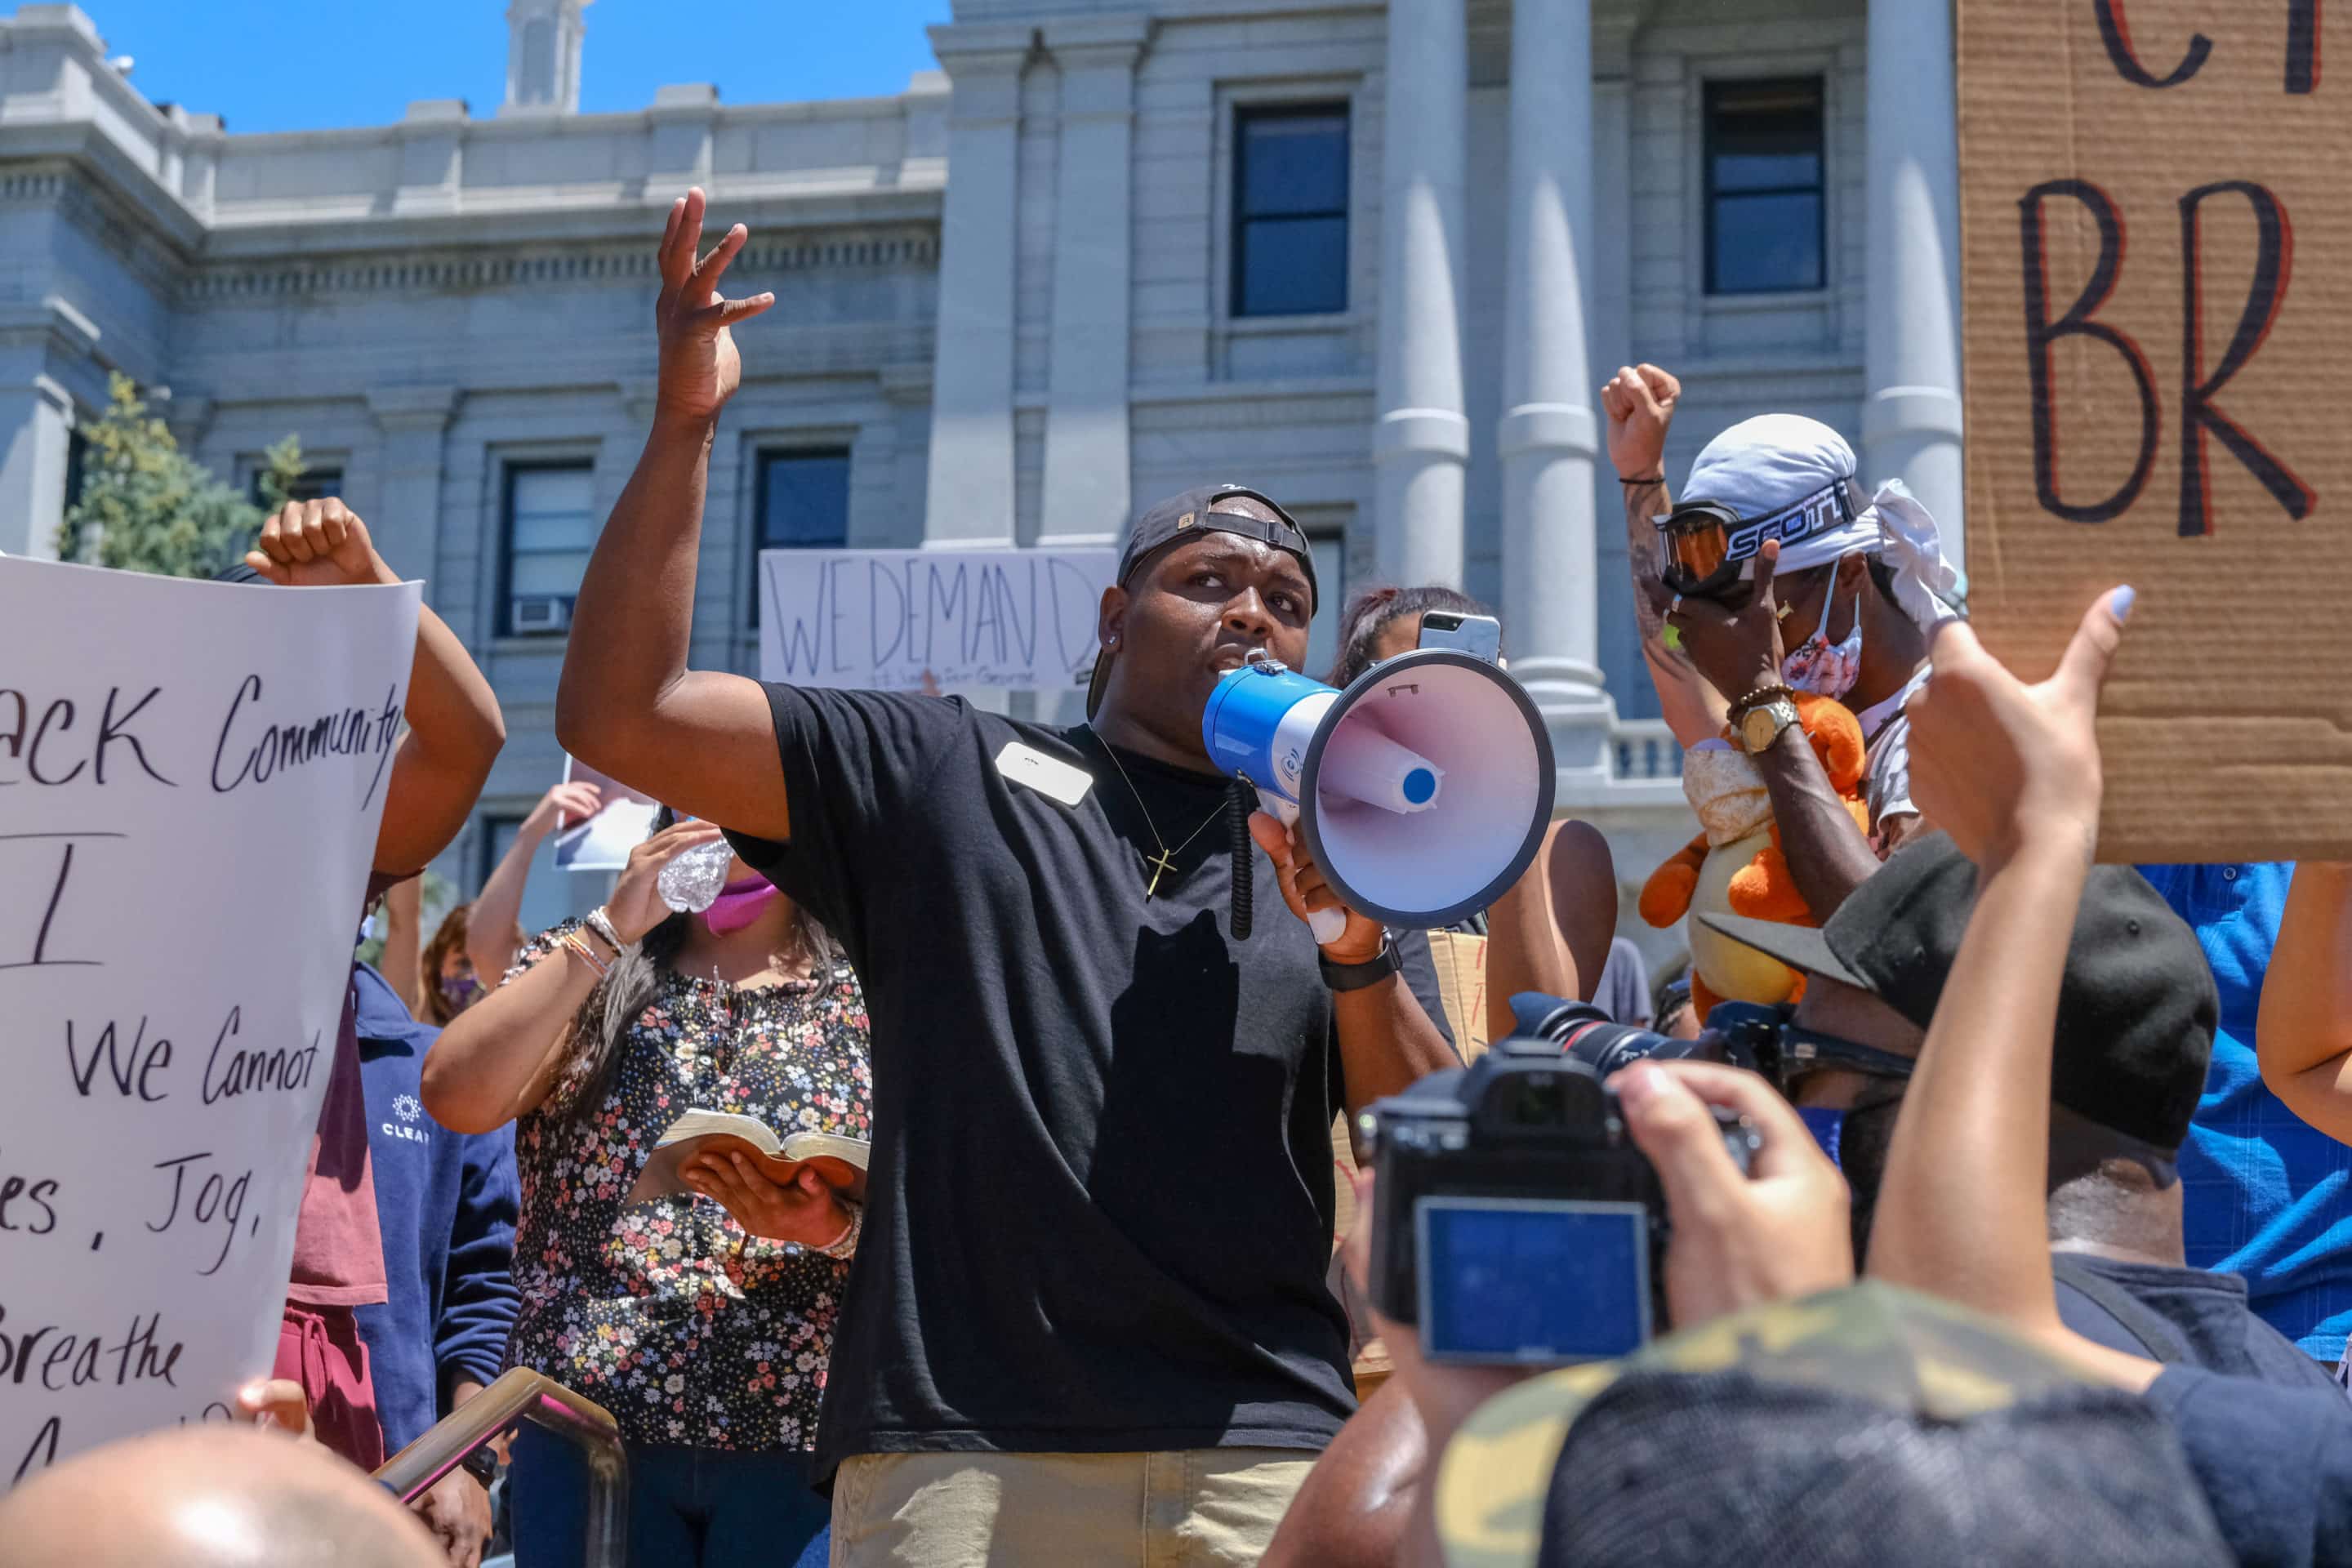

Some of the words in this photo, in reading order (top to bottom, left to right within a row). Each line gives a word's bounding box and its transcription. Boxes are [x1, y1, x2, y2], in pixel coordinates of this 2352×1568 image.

[766, 558, 855, 676] WE
[870, 556, 1099, 674] DEMAND
[65, 1015, 173, 1102] We
[203, 1004, 322, 1106] Cannot
[145, 1152, 261, 1276] Jog,
